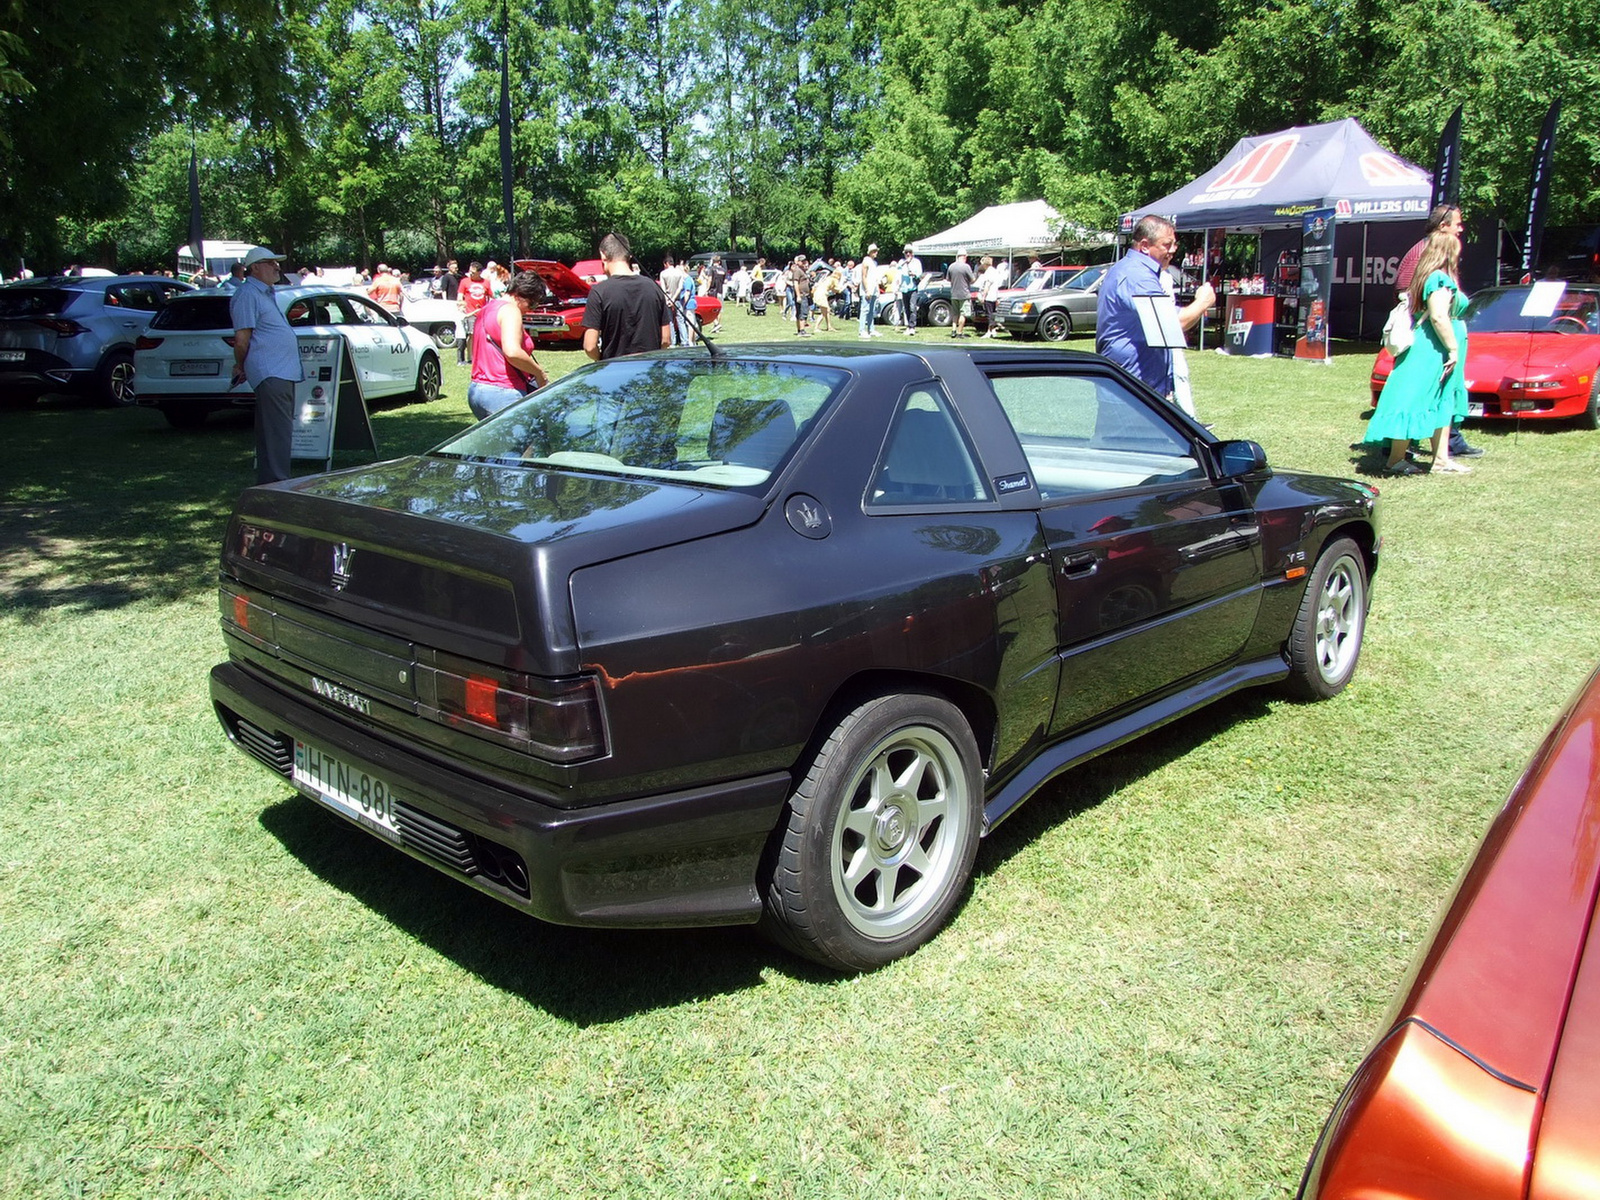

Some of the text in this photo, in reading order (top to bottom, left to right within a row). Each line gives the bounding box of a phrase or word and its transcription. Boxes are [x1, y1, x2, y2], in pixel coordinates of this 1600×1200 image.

[1354, 200, 1428, 214] MILLERS OILS
[1522, 187, 1538, 269] MILLERS
[1331, 257, 1399, 284] LLERS
[391, 343, 410, 354] KIA
